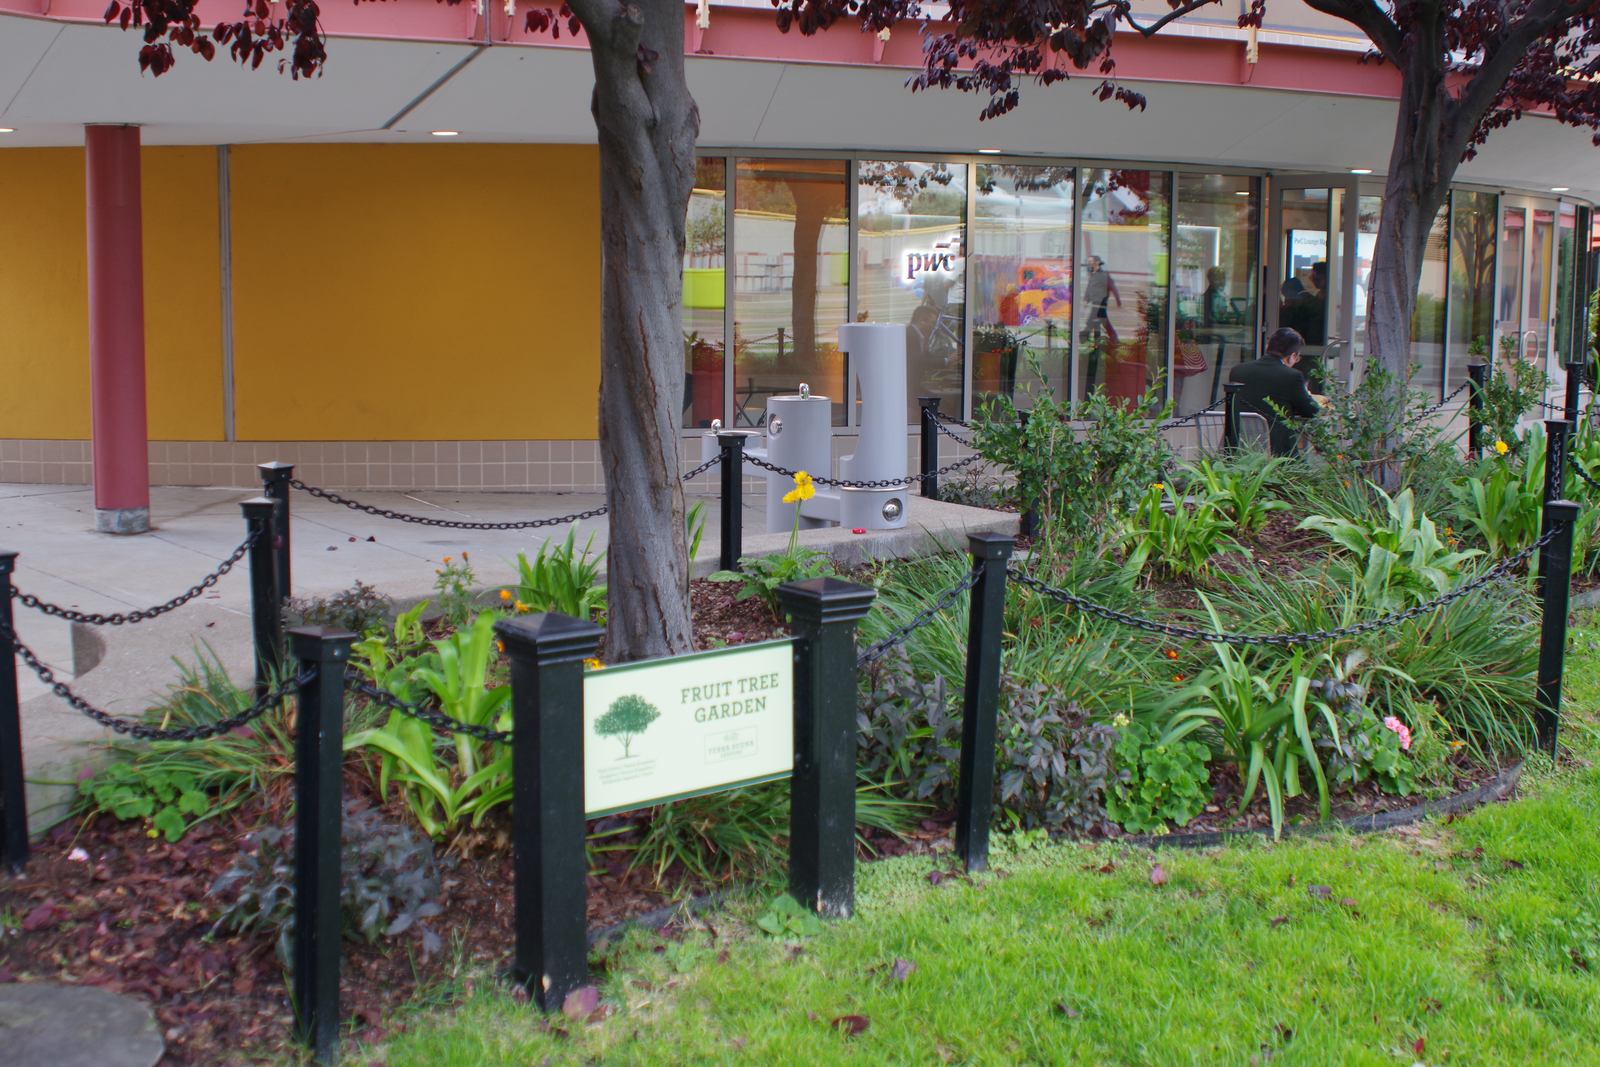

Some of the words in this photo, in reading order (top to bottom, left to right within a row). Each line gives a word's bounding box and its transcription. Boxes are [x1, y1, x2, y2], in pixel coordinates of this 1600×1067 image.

[906, 252, 956, 280] pwc
[681, 681, 732, 704] FRUIT
[737, 673, 779, 694] TREE
[694, 696, 767, 723] GARDEN
